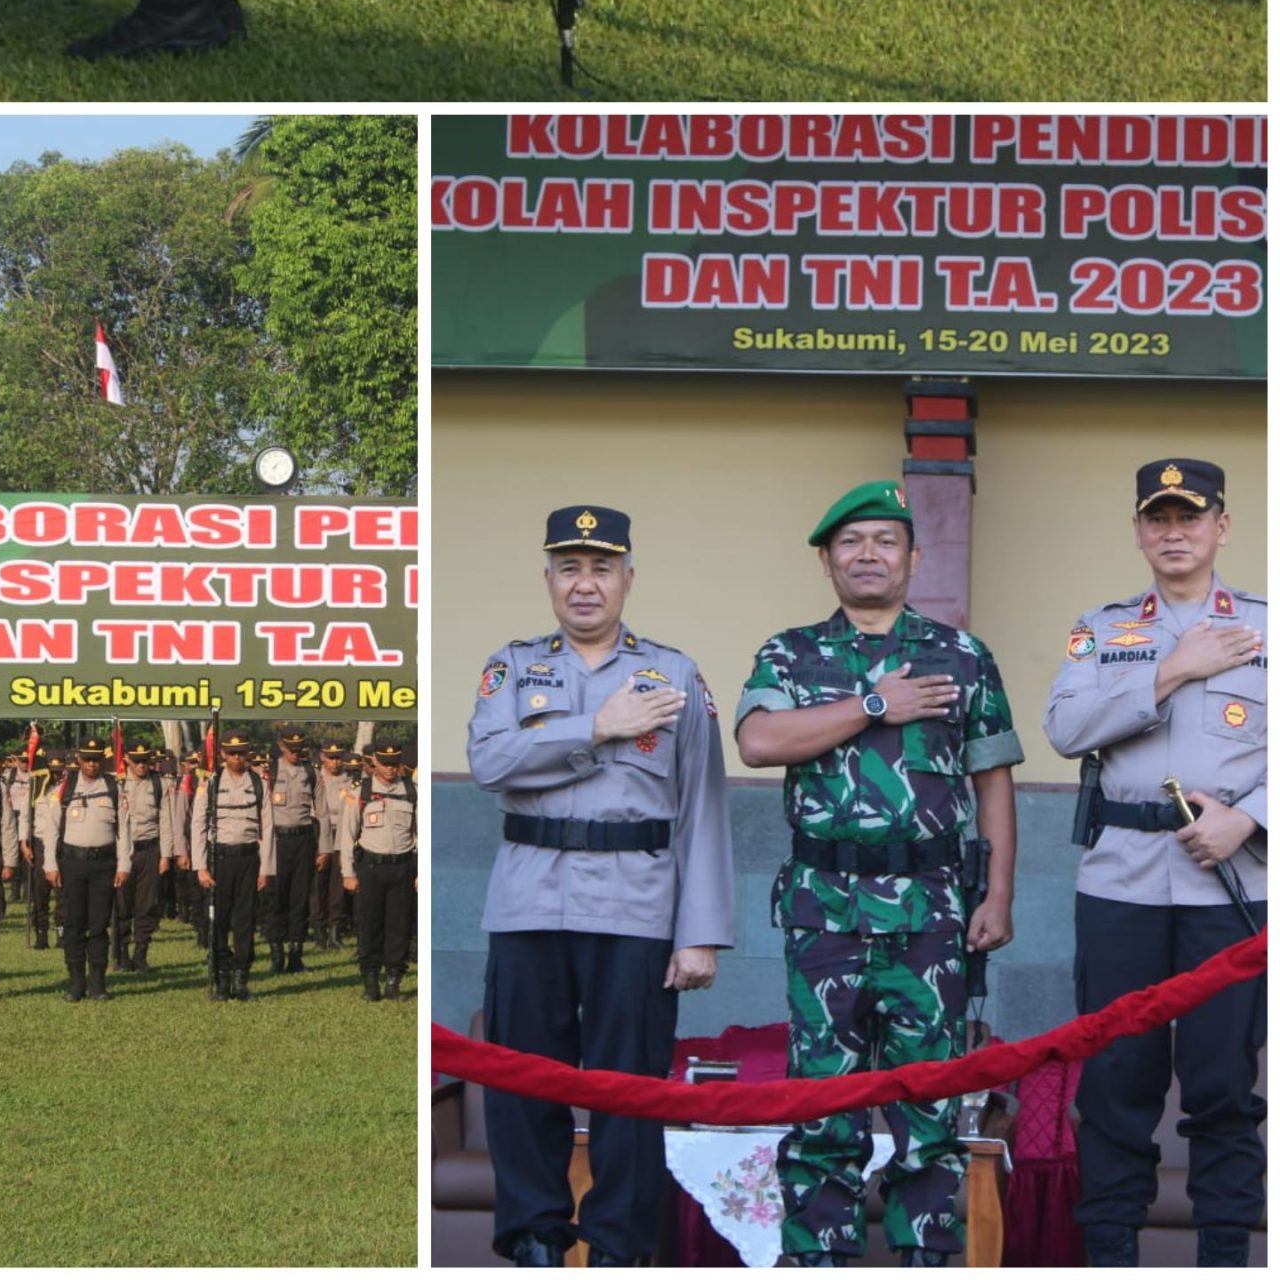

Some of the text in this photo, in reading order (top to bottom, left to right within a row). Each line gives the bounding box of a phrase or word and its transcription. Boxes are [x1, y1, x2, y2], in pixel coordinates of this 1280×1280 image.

[508, 115, 1268, 167] KOLABORASI PENDIDI
[649, 181, 1045, 237] INSPEKTUR
[643, 255, 1262, 315] DAN TNI T.A. 2023
[732, 327, 1171, 356] Sukabumi, 15-20 Mei 2023
[94, 620, 239, 665] TNI
[257, 623, 402, 666] T.A.
[1100, 649, 1158, 664] MARDIAZ
[9, 677, 222, 711] Sukabumi,
[236, 679, 345, 709] 15-20
